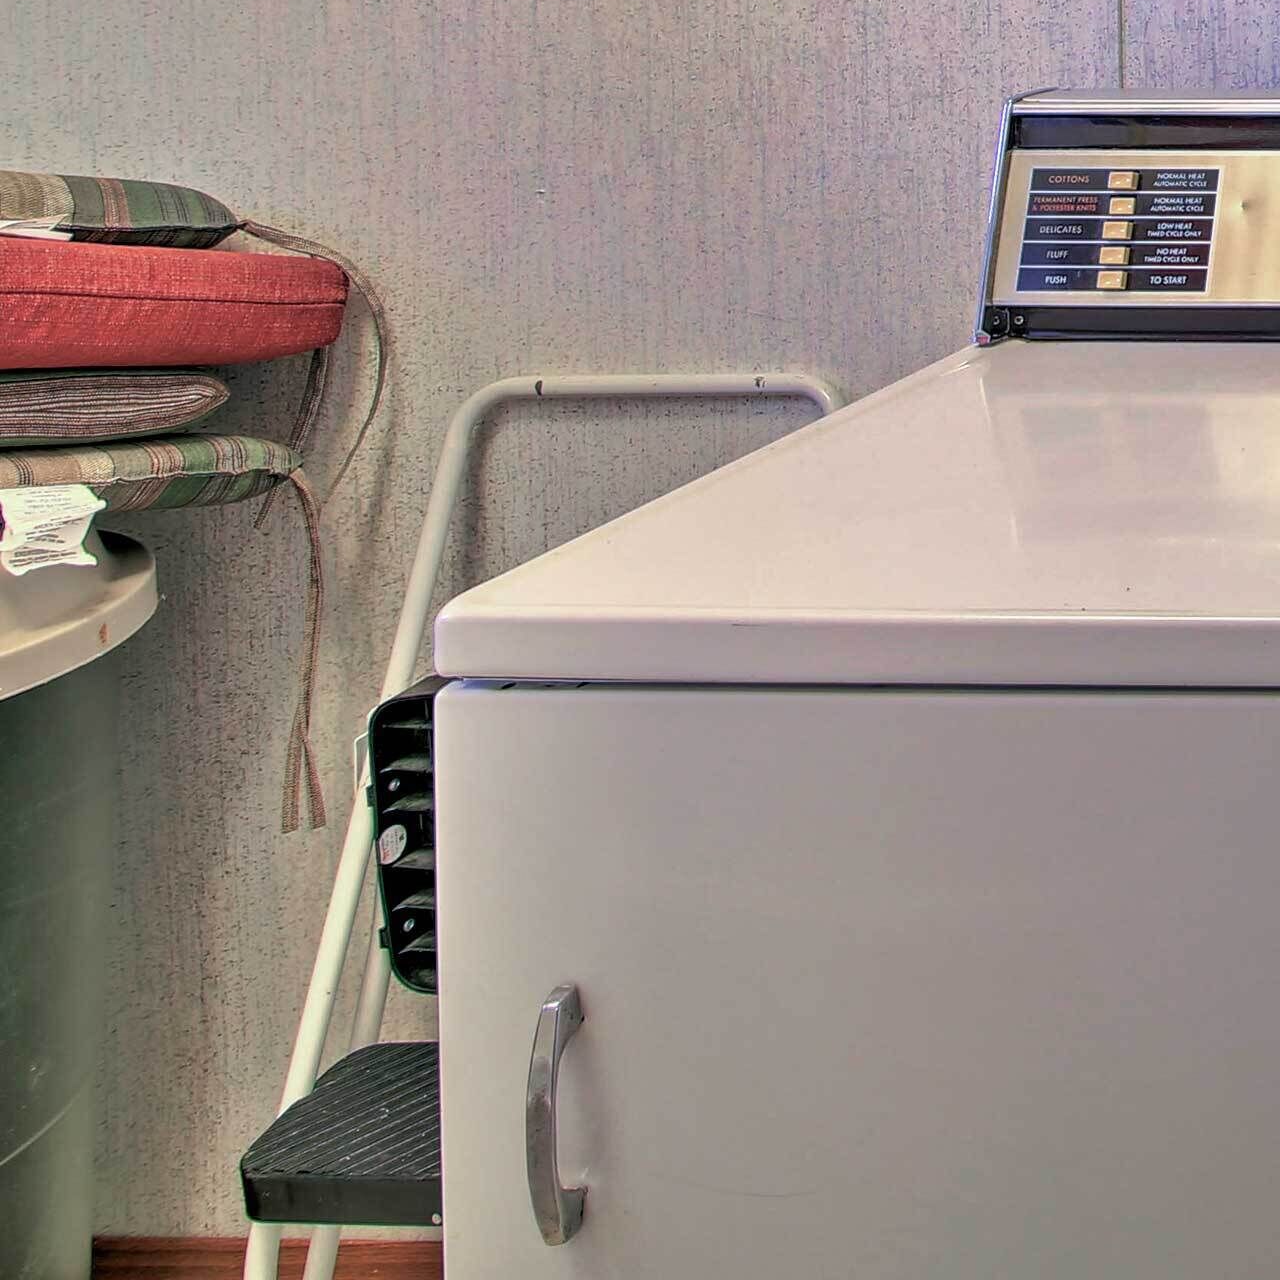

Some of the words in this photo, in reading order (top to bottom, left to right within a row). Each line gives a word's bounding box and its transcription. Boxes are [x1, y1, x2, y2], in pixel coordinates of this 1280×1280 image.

[1048, 175, 1090, 184] COTTONS
[1039, 225, 1082, 234] DELICATES
[1046, 250, 1069, 259] FLUFF
[1045, 275, 1067, 284] PUSH
[1150, 276, 1162, 284] TO
[1163, 276, 1187, 284] START
